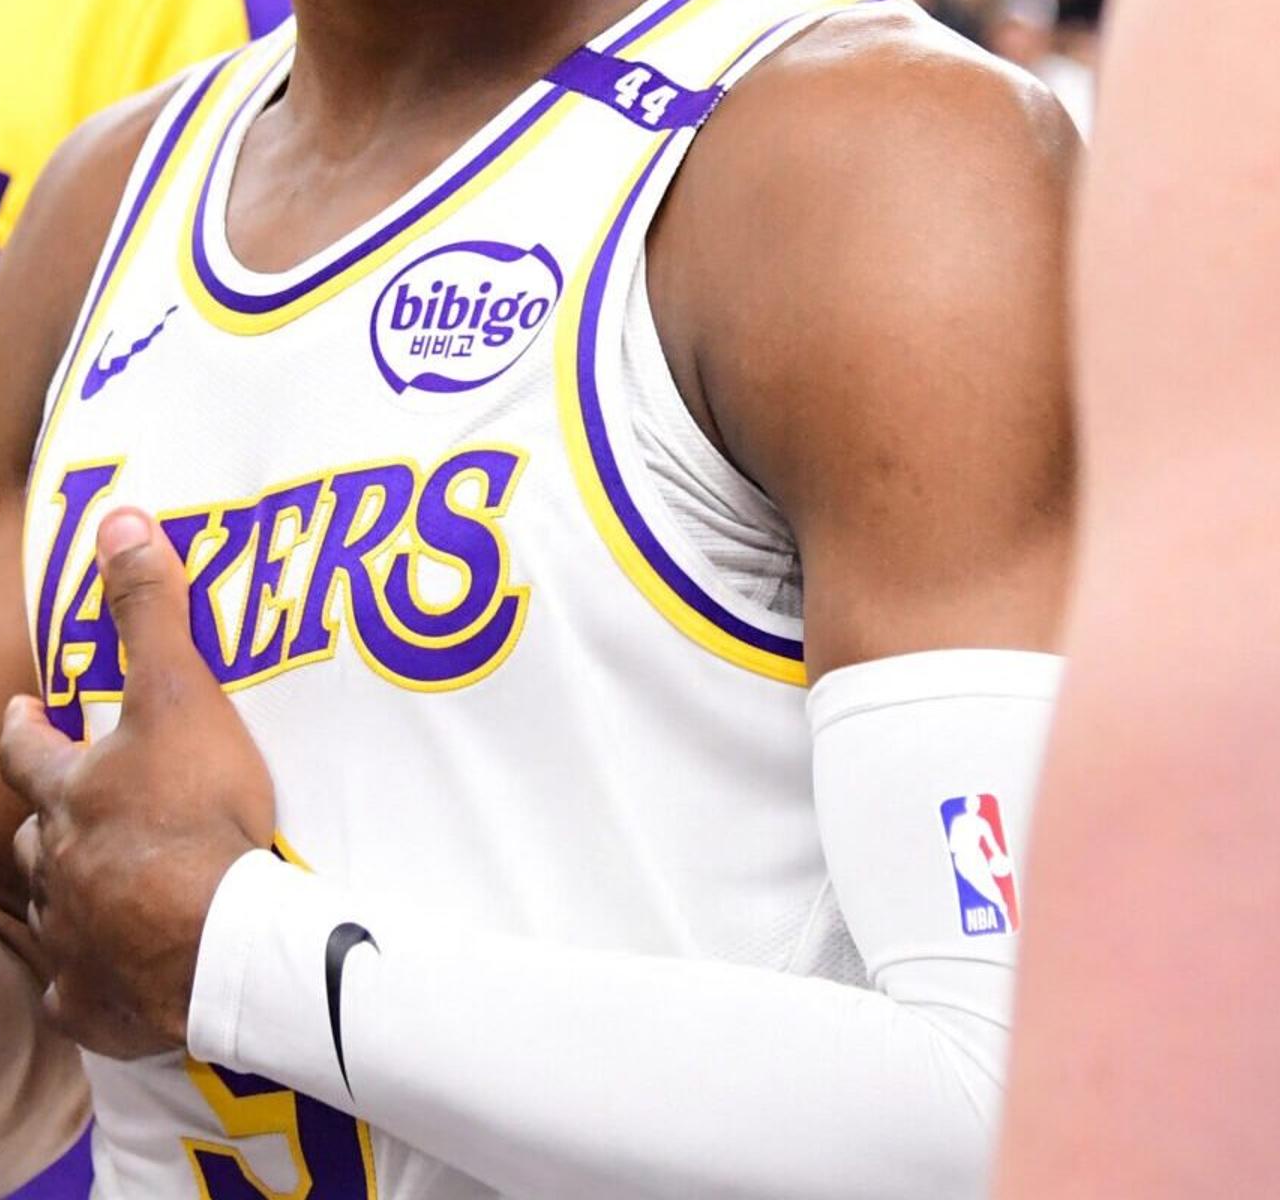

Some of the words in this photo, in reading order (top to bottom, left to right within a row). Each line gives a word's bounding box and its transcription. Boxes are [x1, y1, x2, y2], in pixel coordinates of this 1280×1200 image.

[613, 66, 680, 126] 44
[390, 279, 551, 348] bibigo
[408, 334, 476, 360] 비비고
[965, 904, 1000, 933] NBA
